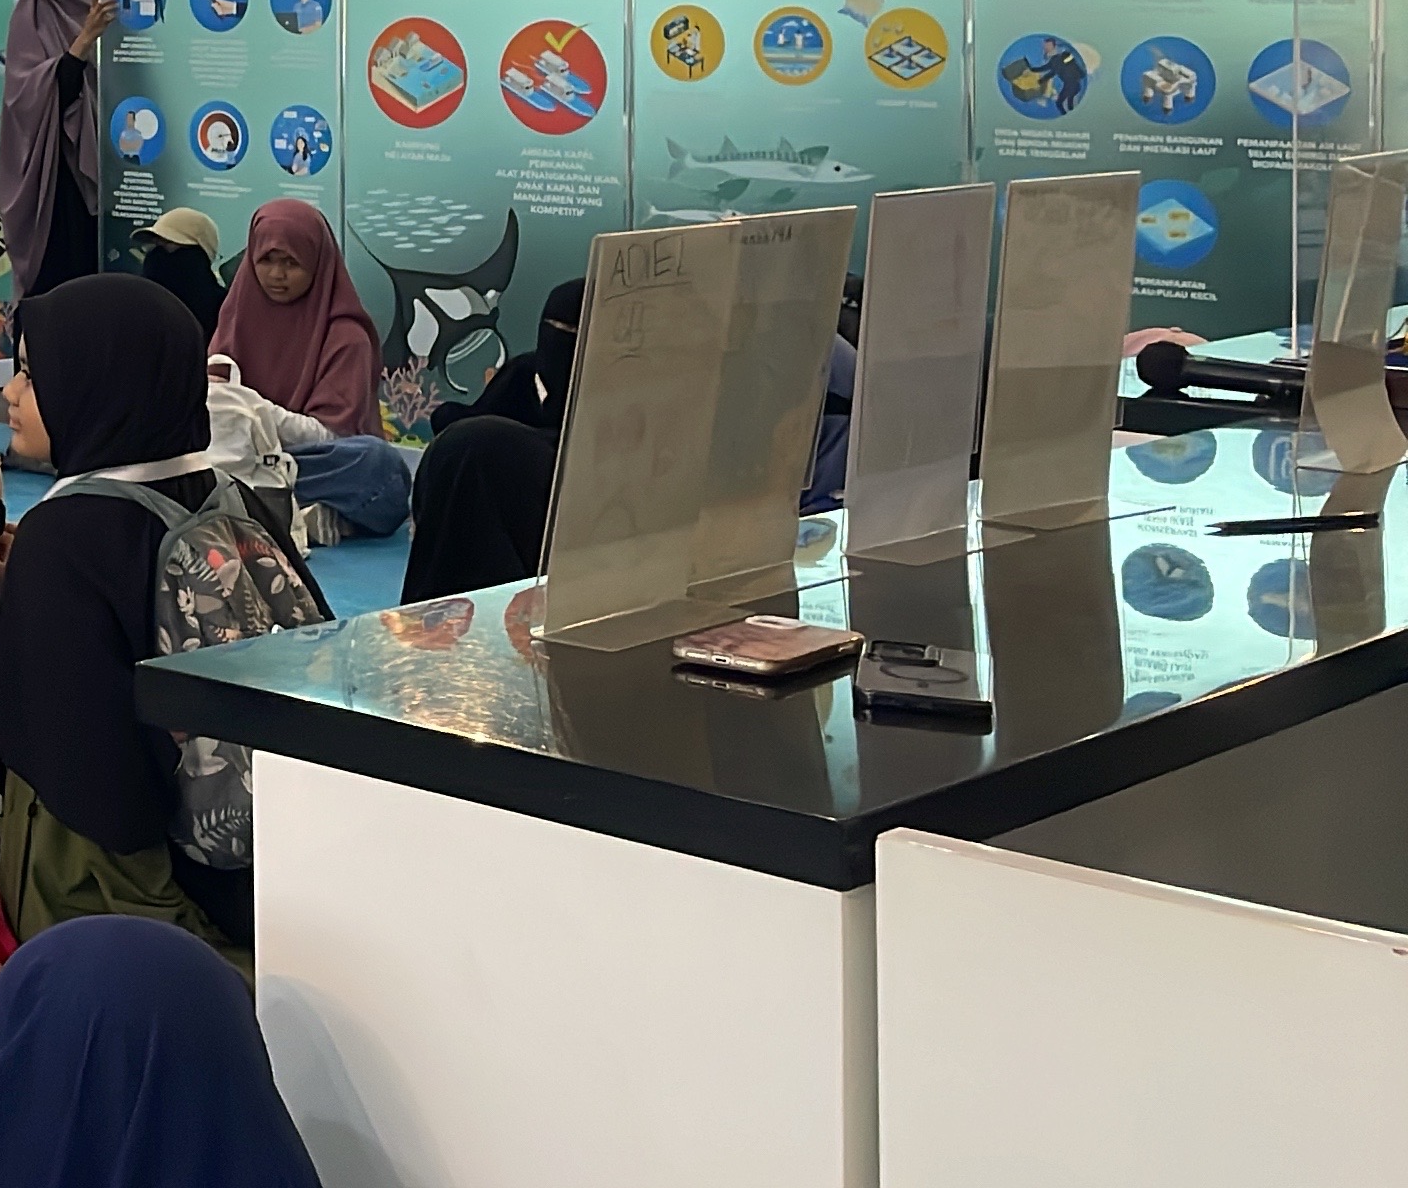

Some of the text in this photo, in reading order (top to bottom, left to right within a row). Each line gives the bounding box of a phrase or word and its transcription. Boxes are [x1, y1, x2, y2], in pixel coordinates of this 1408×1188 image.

[1119, 143, 1141, 152] DAN
[1191, 146, 1218, 156] LAUT
[495, 169, 518, 178] ALAT
[516, 181, 600, 194] AWAK KAPAL DAN
[513, 192, 603, 208] MANAJEMEN YANG
[530, 204, 585, 217] KOMPETITIF
[1133, 276, 1206, 290] PEMANFAATAN
